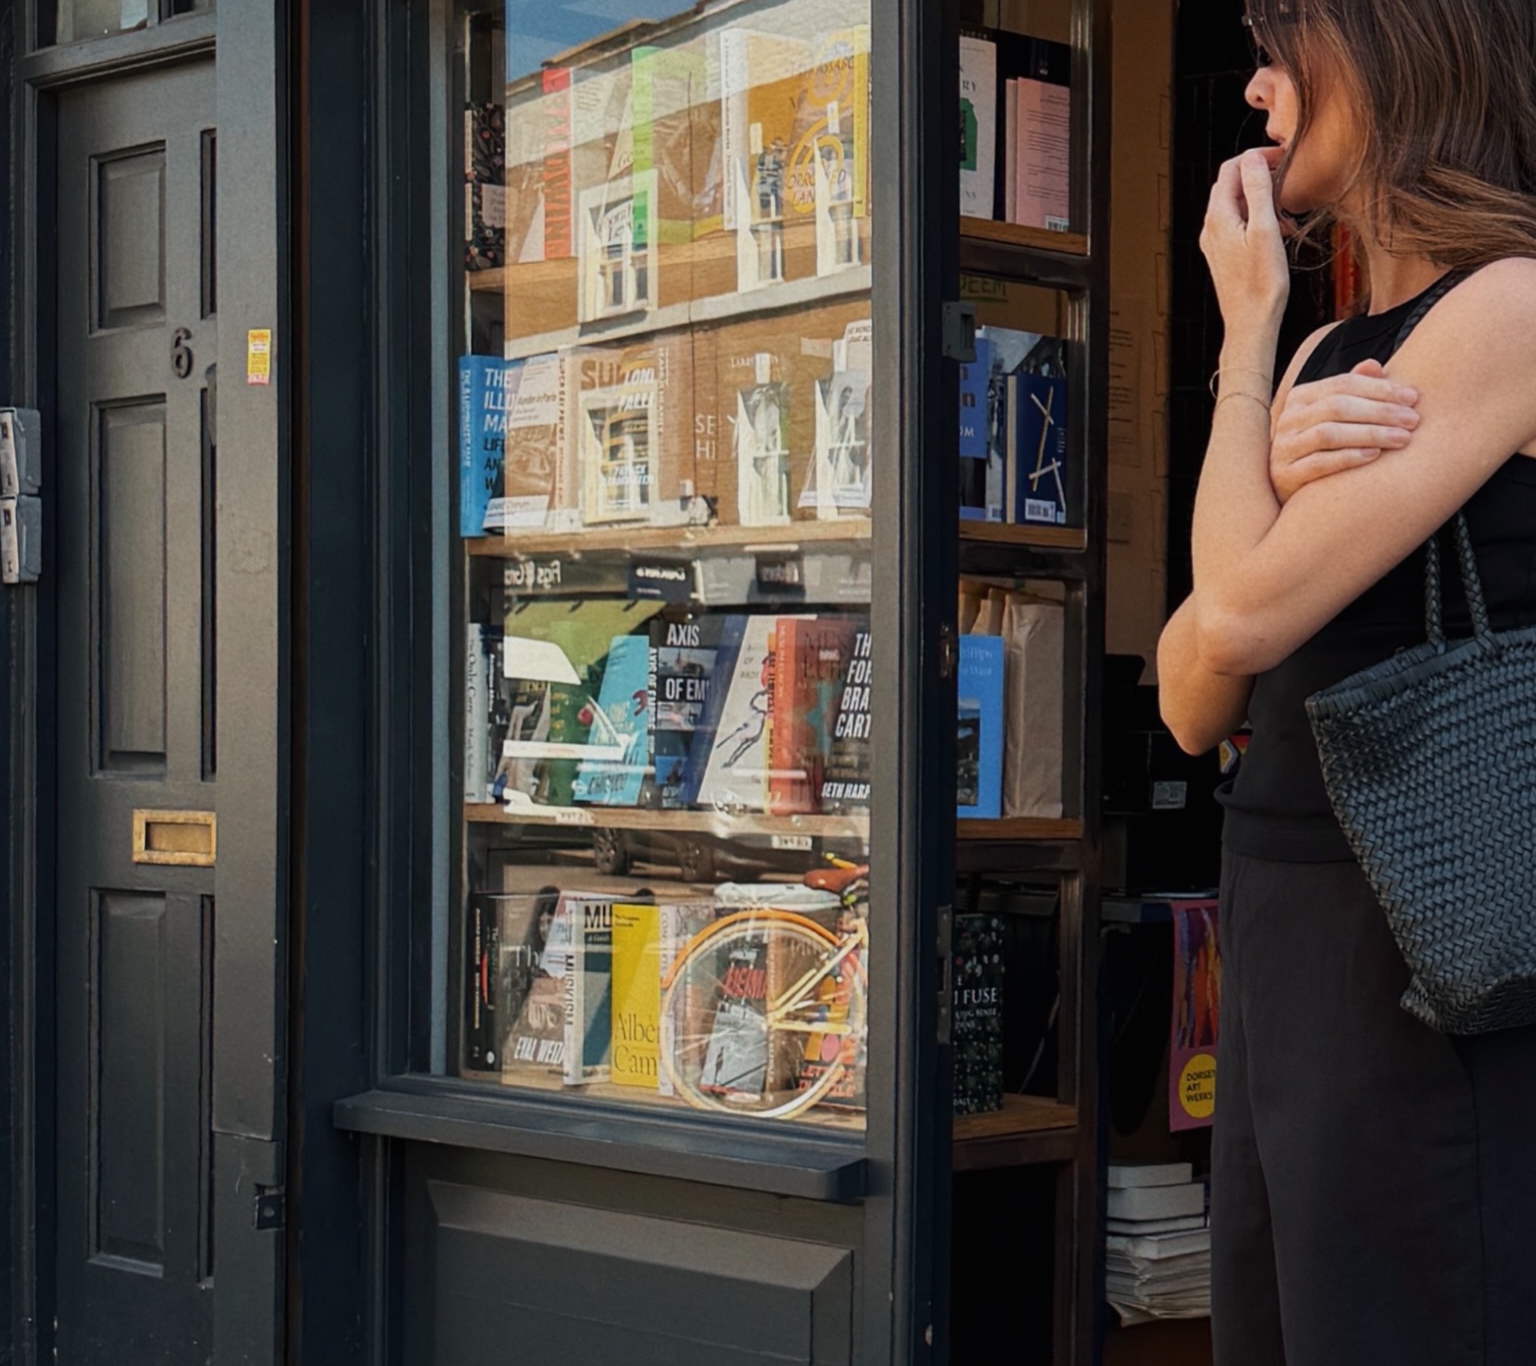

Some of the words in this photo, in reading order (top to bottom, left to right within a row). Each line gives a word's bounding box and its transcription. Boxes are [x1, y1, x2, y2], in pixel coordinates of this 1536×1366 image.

[170, 326, 193, 379] 6
[484, 368, 513, 389] THE
[484, 414, 508, 433] MA
[666, 623, 701, 647] AXIS
[664, 678, 683, 701] OF
[963, 987, 999, 1006] FUSE
[1186, 1082, 1201, 1092] ART
[1186, 1092, 1213, 1103] WEEKS
